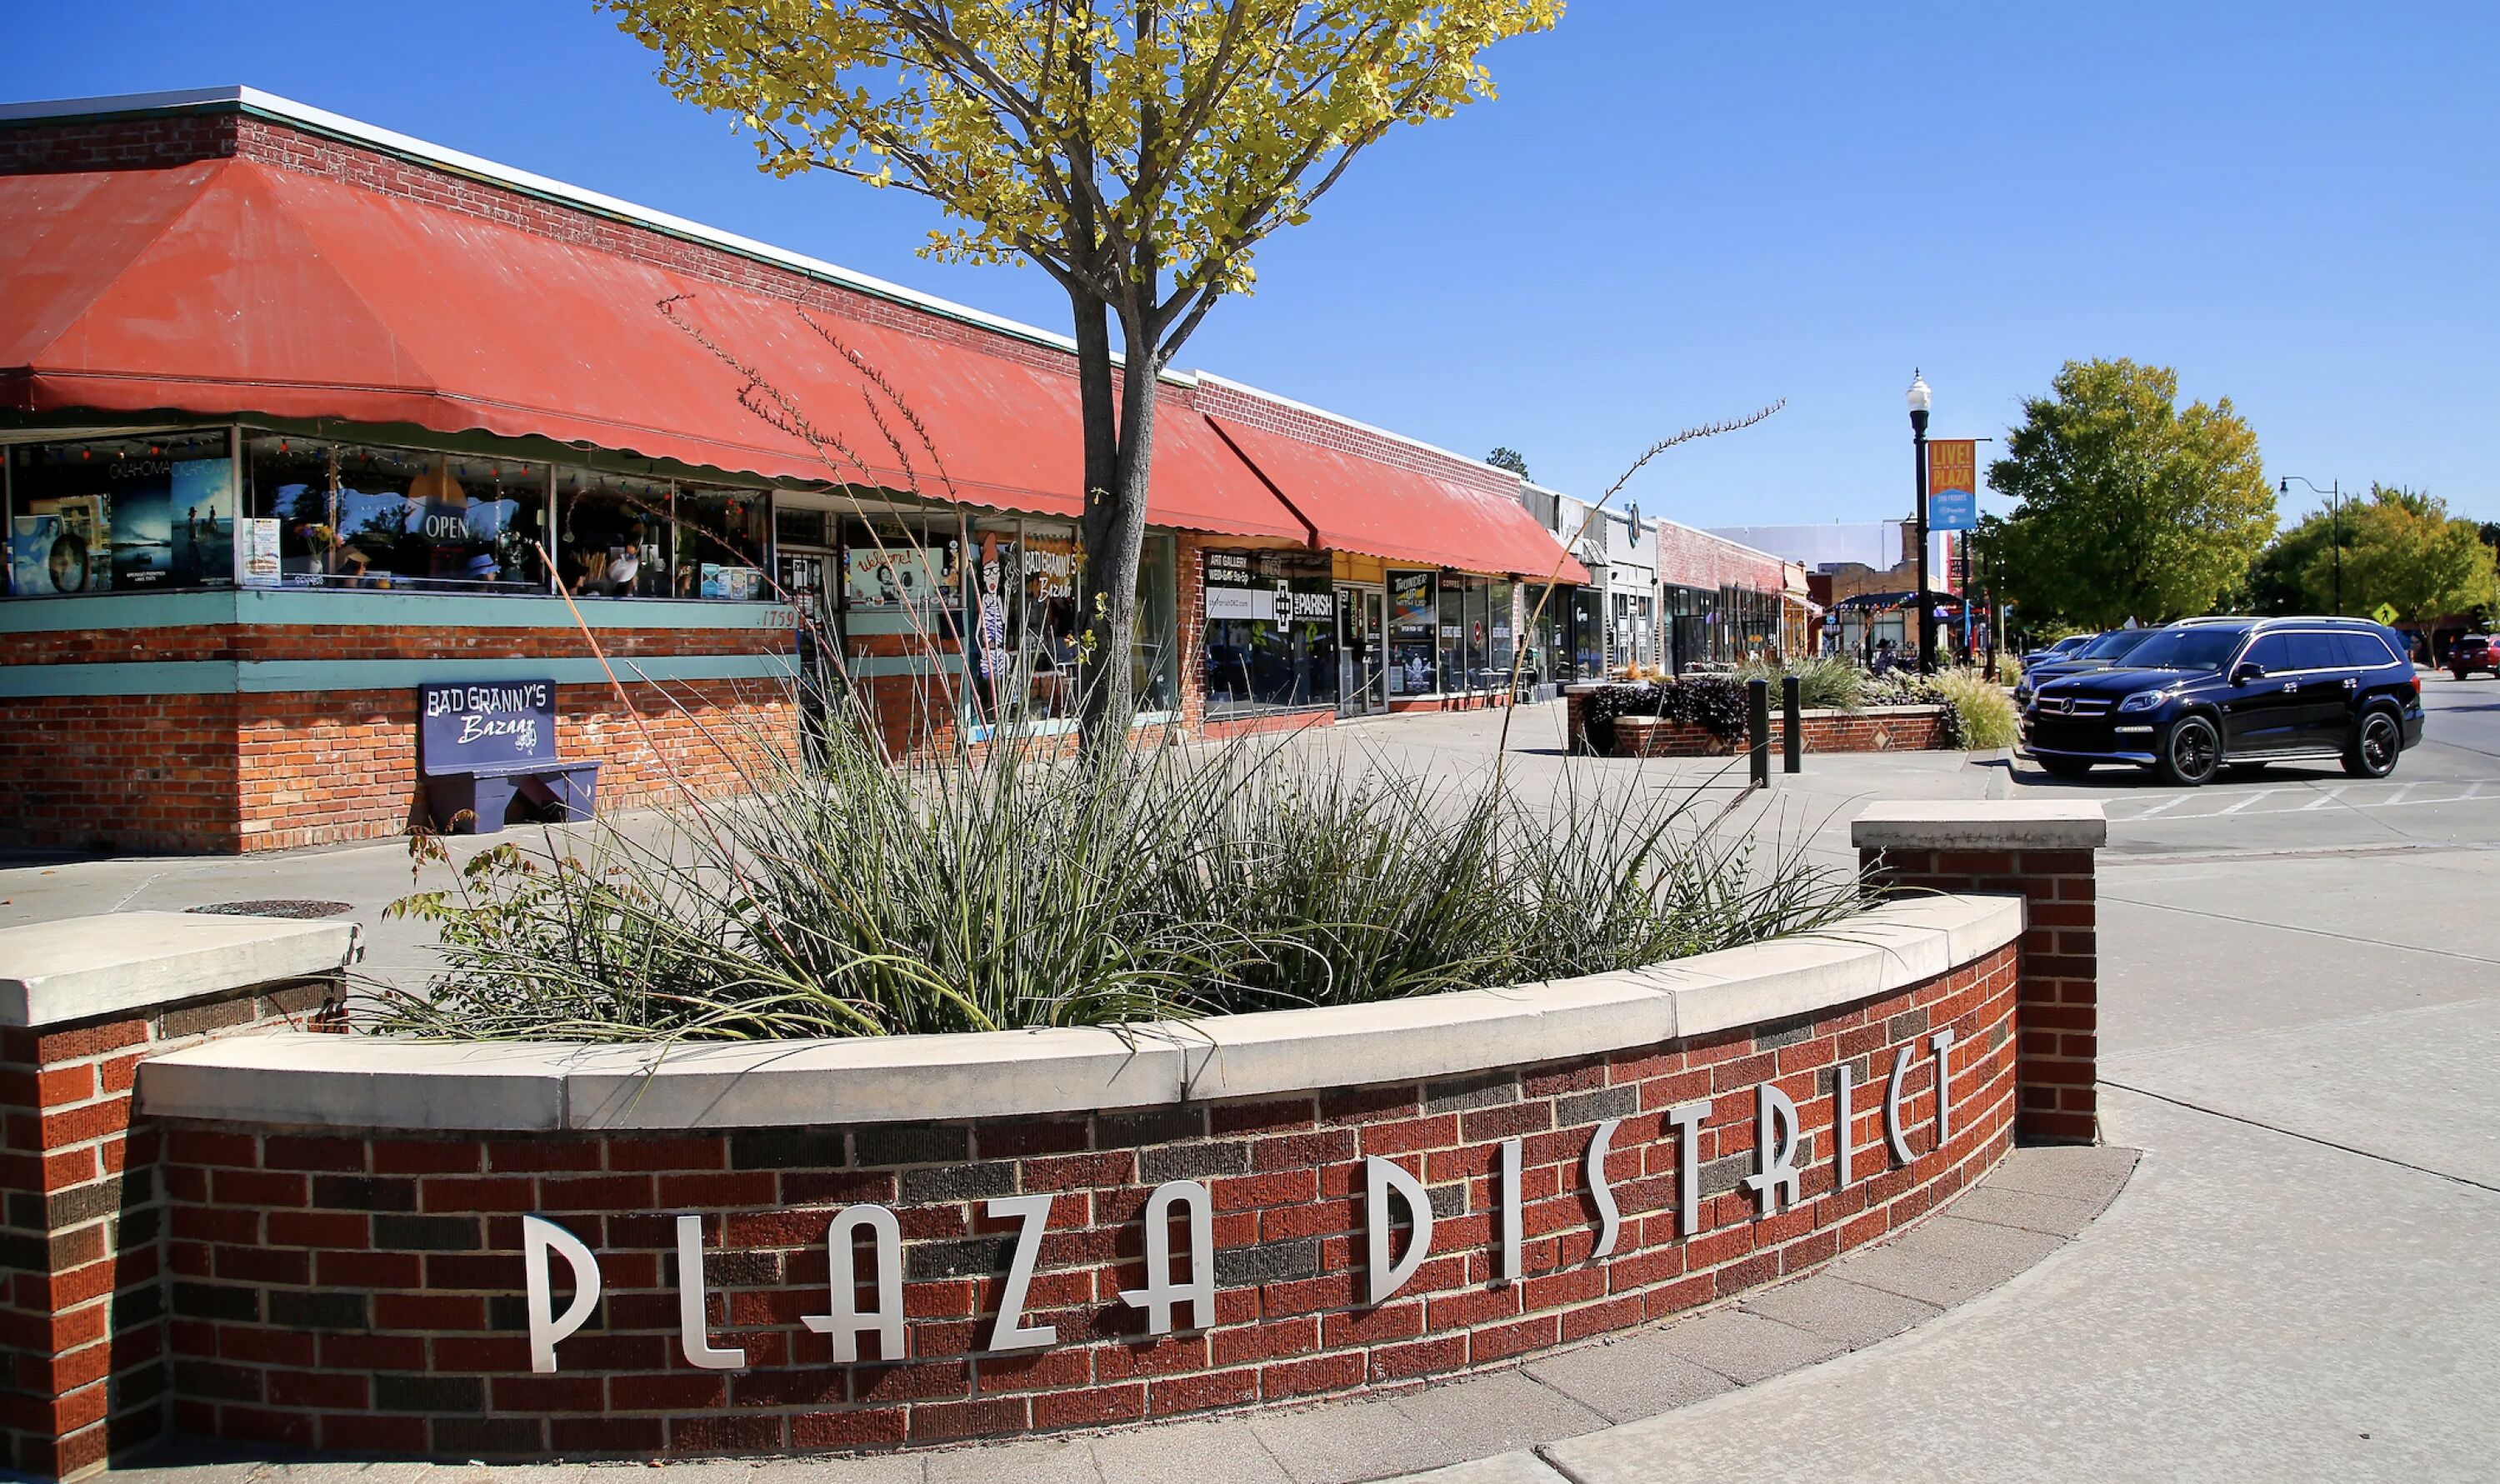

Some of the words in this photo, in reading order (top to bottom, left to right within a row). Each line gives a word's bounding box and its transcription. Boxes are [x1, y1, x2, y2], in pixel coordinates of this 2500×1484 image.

[1932, 444, 1970, 465] LIVE!
[109, 461, 171, 480] OKLAHOMA
[1933, 469, 1971, 487] PLAZA
[426, 514, 470, 539] OPEN
[857, 550, 912, 572] Welcome!
[1025, 551, 1040, 575] BAD
[1210, 554, 1222, 567] ART
[1222, 555, 1248, 567] GALLERY
[1394, 573, 1428, 592] THUNDER
[1299, 593, 1332, 616] PARISH
[1406, 588, 1417, 600] UP
[762, 610, 795, 627] 1759
[427, 688, 464, 717] BAD
[468, 684, 547, 715] GRANNY'S
[458, 714, 536, 744] Bazaar
[523, 1180, 1216, 1374] PLAZA
[1366, 1028, 1955, 1307] DISTRICT
